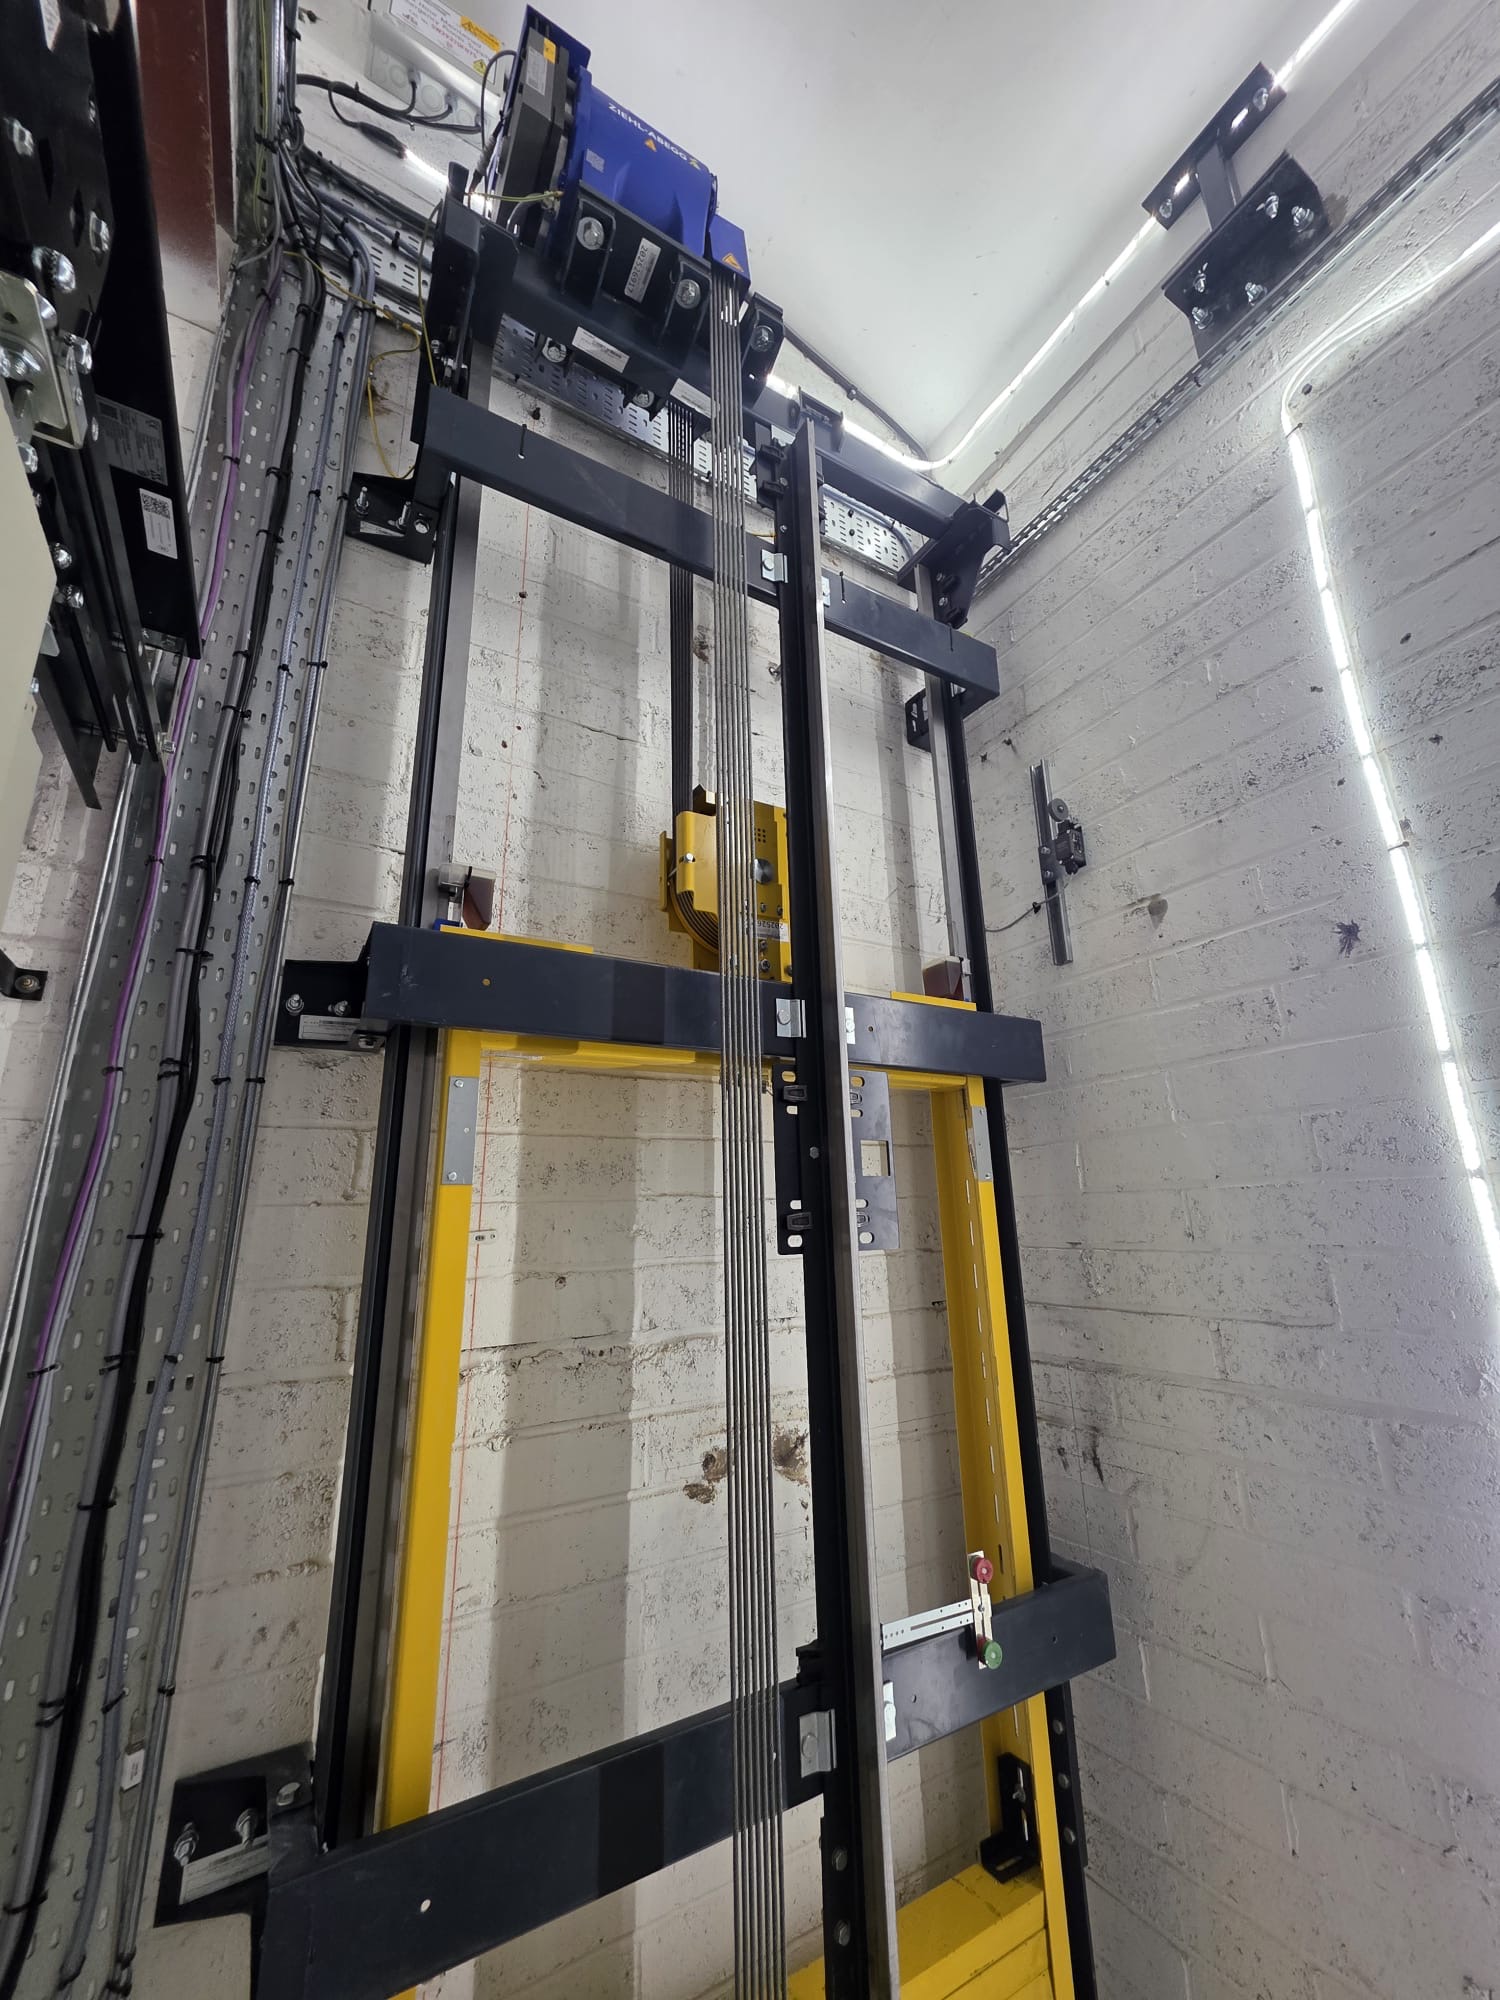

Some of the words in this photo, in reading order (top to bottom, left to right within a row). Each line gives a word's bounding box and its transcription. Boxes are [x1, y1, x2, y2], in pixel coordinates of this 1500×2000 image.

[608, 102, 688, 161] ZIEHL-ABEGG
[627, 244, 648, 293] 202526917
[757, 920, 784, 929] 202526
